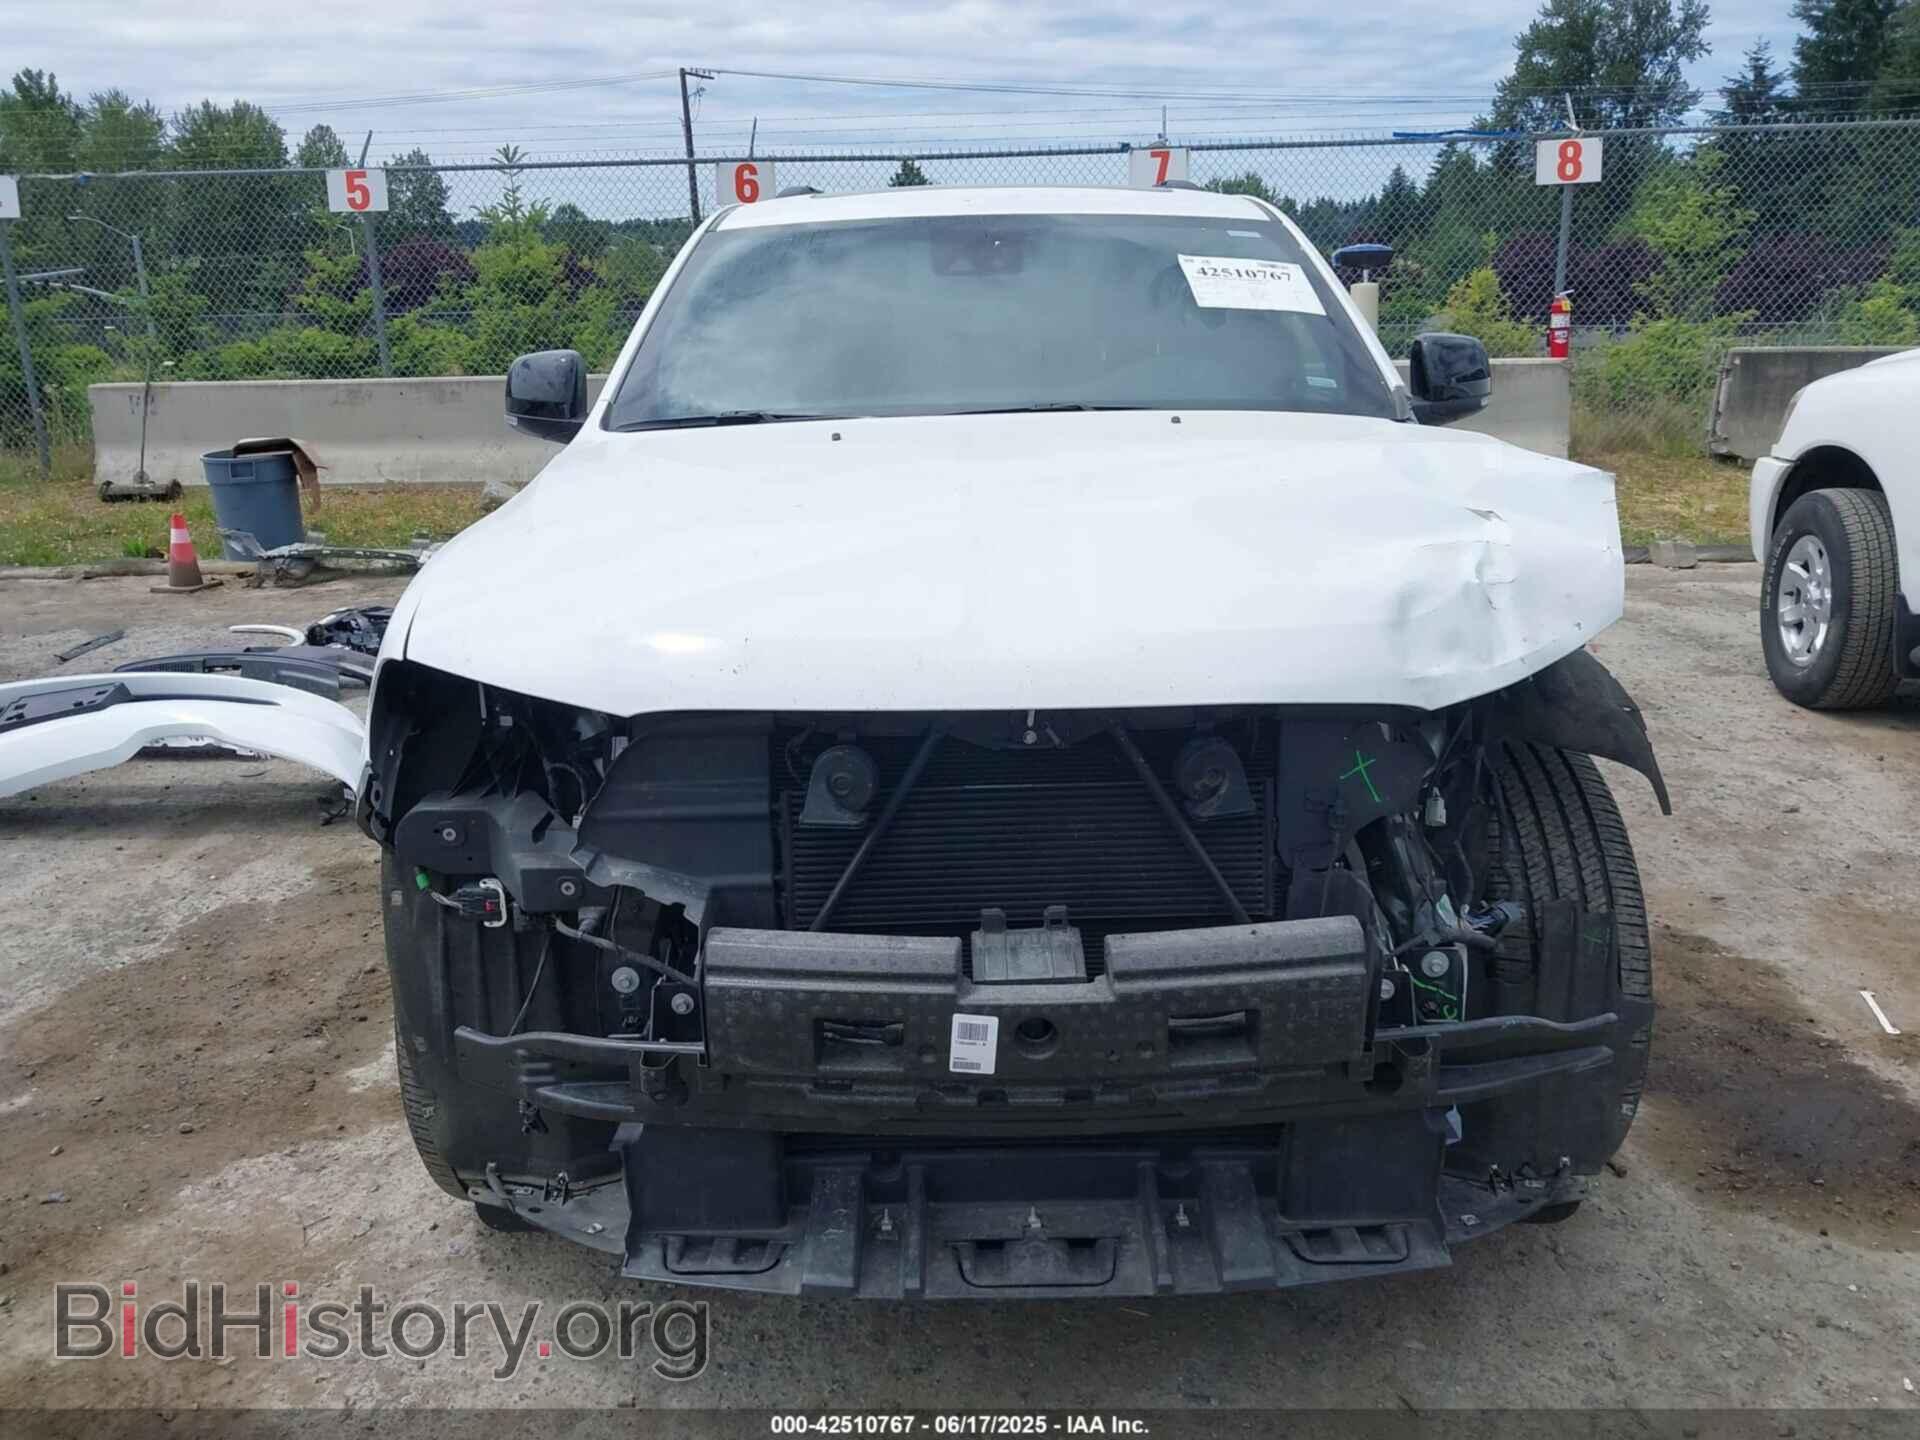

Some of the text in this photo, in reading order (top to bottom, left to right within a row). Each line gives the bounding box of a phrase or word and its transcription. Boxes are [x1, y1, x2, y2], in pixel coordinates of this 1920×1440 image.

[1150, 150, 1171, 187] 7
[1557, 139, 1584, 183] 8
[345, 170, 371, 212] 5
[735, 163, 760, 205] 6
[1197, 266, 1291, 282] 42510767
